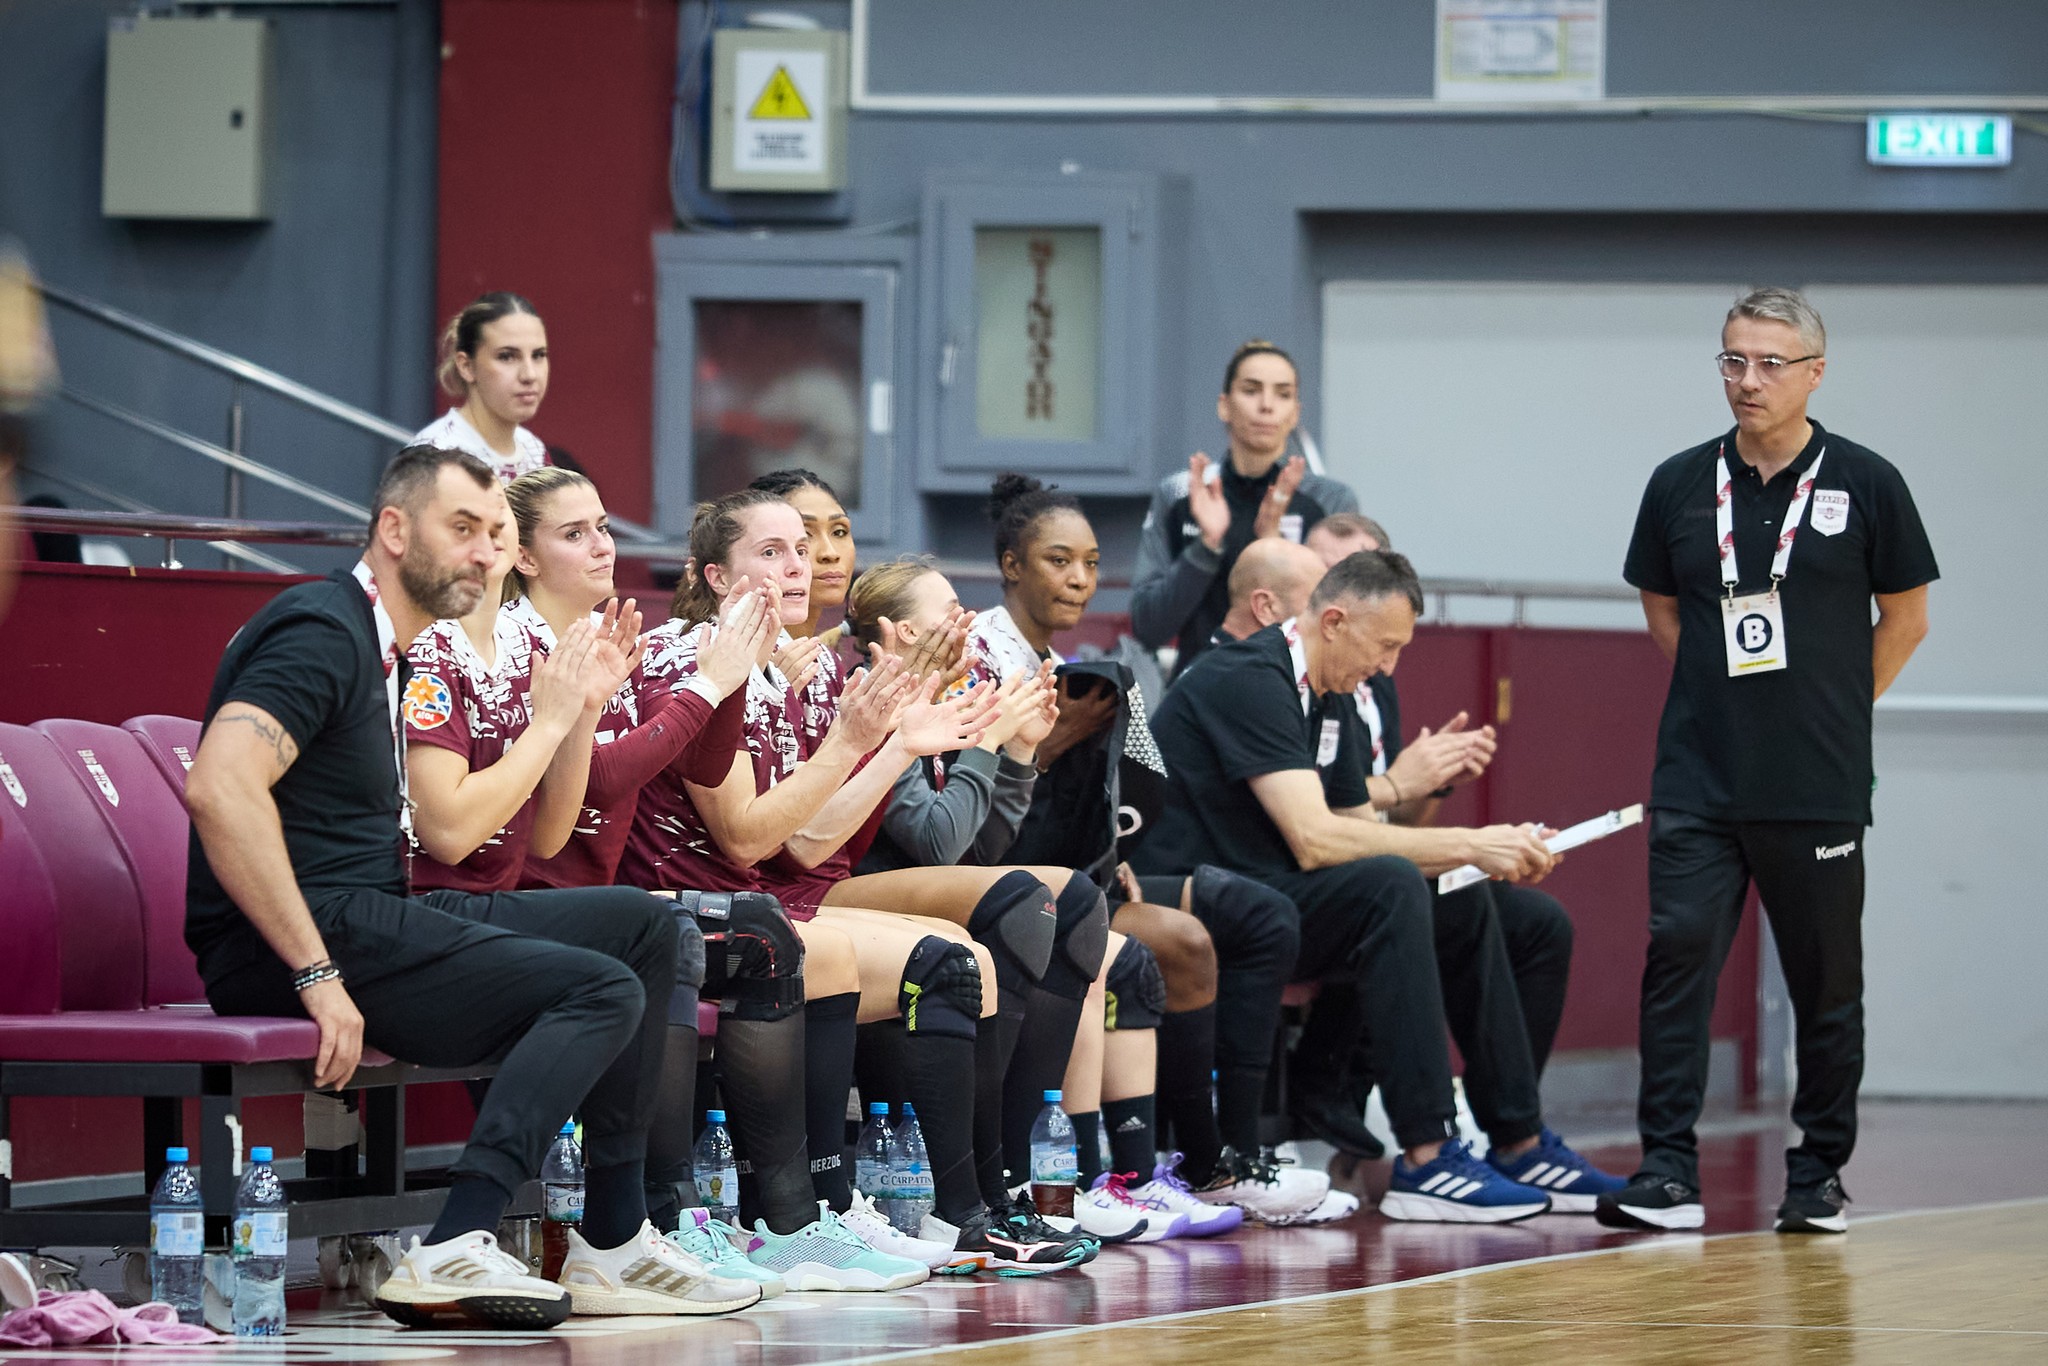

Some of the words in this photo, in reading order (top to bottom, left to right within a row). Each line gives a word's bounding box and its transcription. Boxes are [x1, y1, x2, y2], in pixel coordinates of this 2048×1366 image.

[1887, 120, 1987, 156] EXIT
[1743, 618, 1767, 649] B
[415, 710, 435, 722] MOL
[811, 1154, 841, 1174] HERZOG
